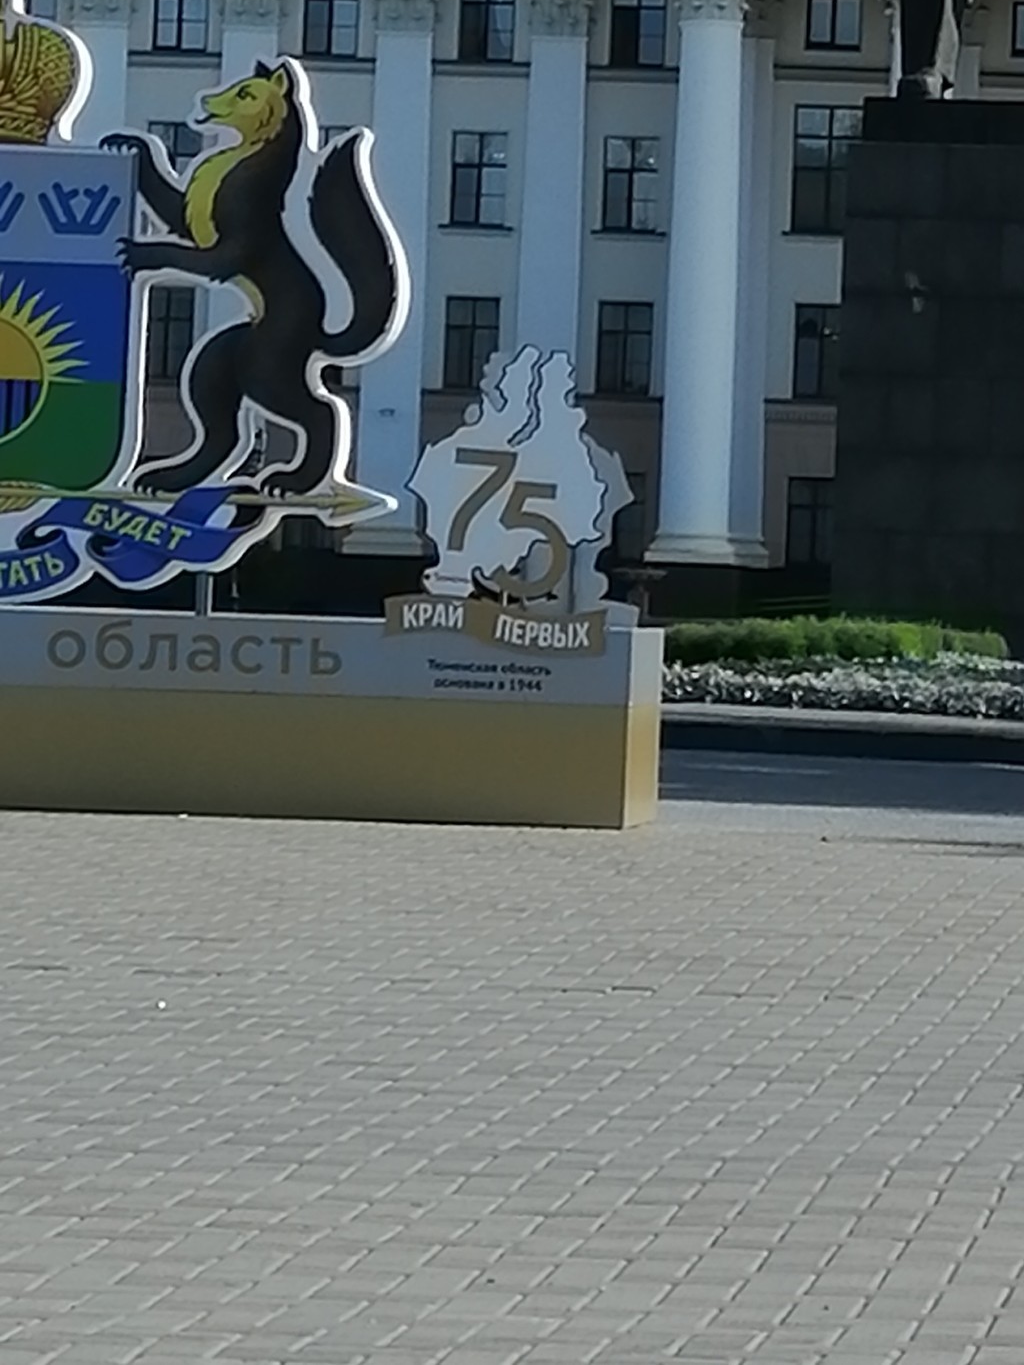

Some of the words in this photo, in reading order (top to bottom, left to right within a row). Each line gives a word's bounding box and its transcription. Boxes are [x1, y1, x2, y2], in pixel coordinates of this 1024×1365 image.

[83, 502, 192, 551] БУДЕТ
[446, 447, 567, 599] 75
[47, 619, 343, 676] область
[402, 601, 465, 630] КРАЙ
[494, 614, 590, 649] ПЕРВЫХ
[500, 661, 551, 676] область
[509, 678, 542, 692] 1944
